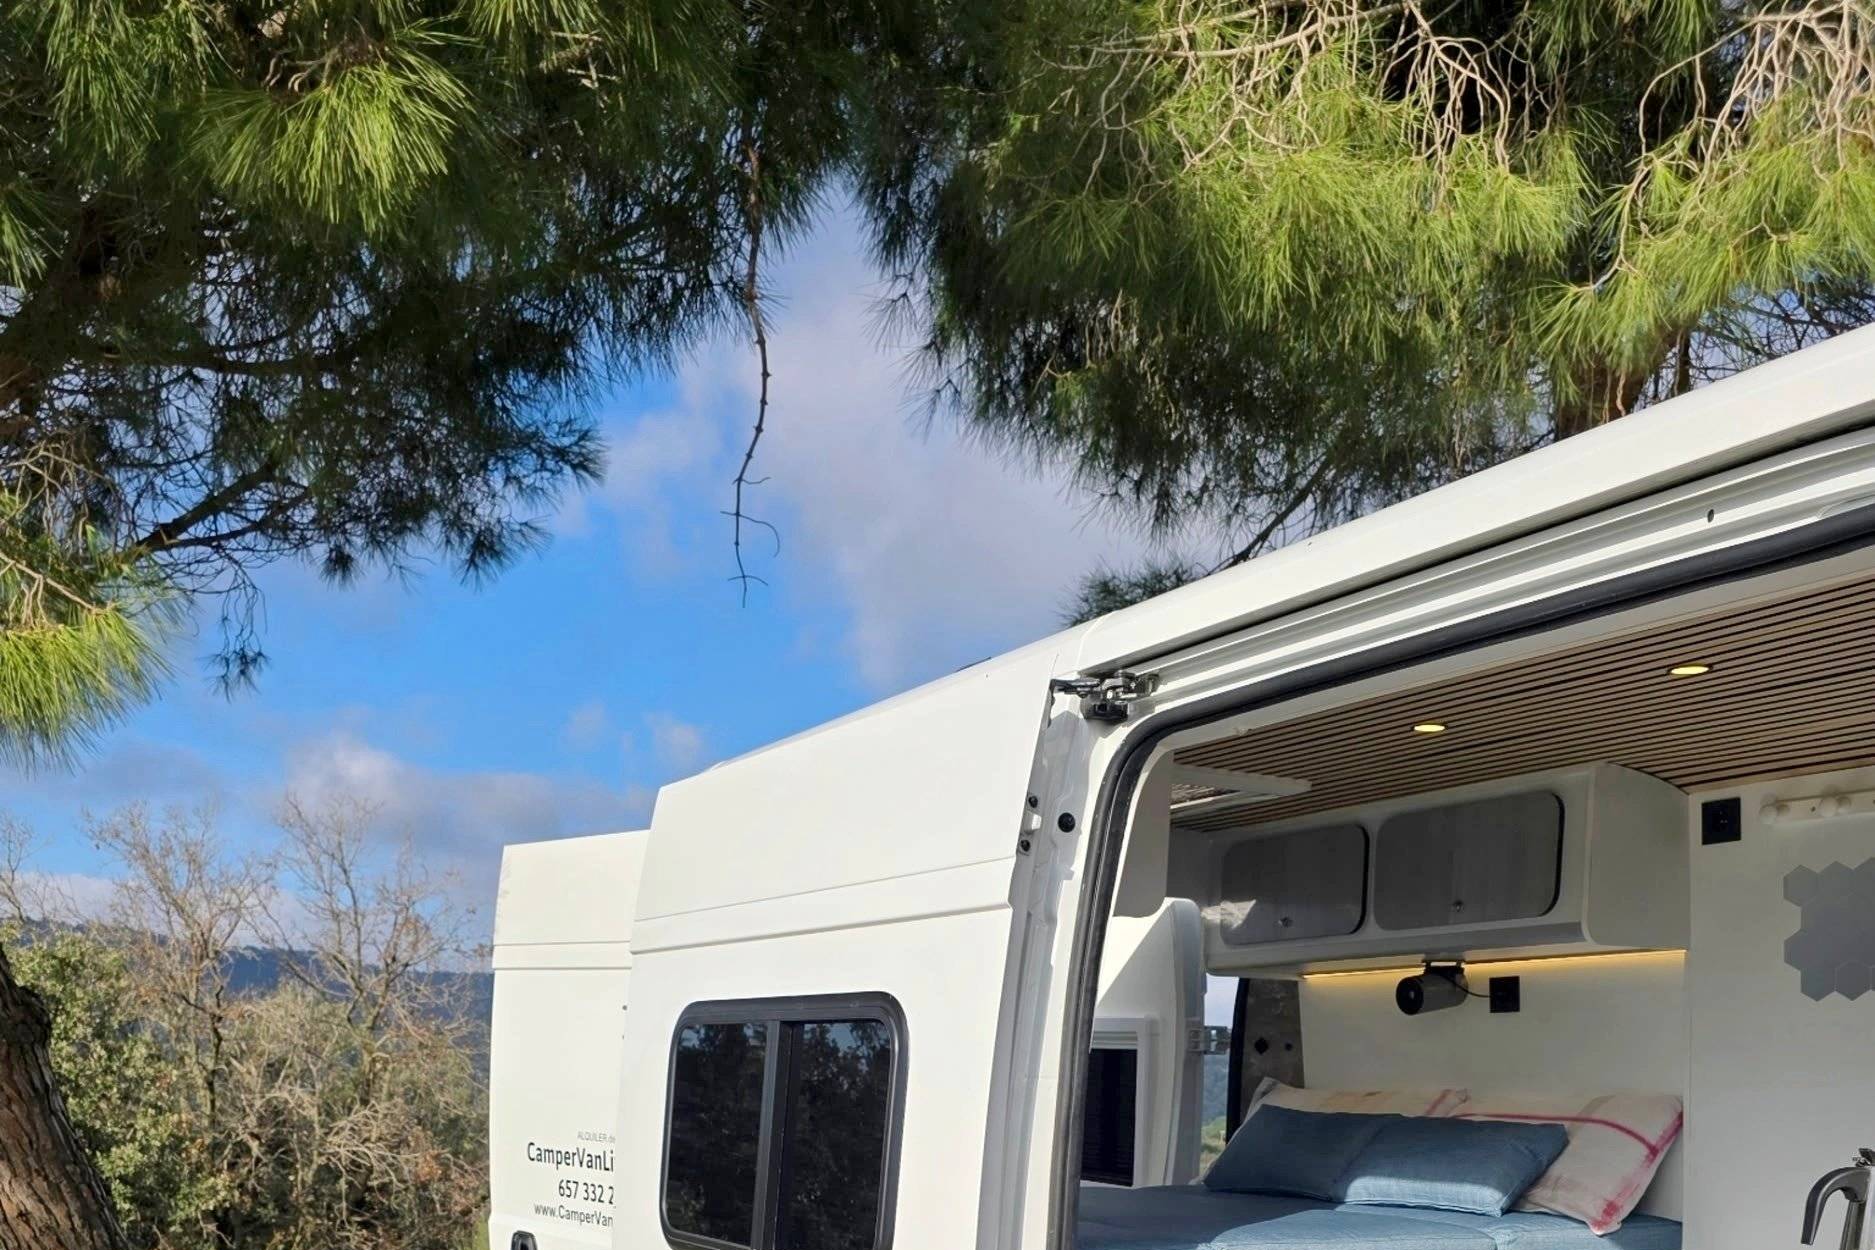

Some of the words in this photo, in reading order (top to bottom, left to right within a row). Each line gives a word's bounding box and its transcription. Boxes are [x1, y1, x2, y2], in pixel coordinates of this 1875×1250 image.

[527, 1142, 614, 1172] CamperVanLi
[558, 1179, 579, 1199] 657
[583, 1182, 604, 1204] 332
